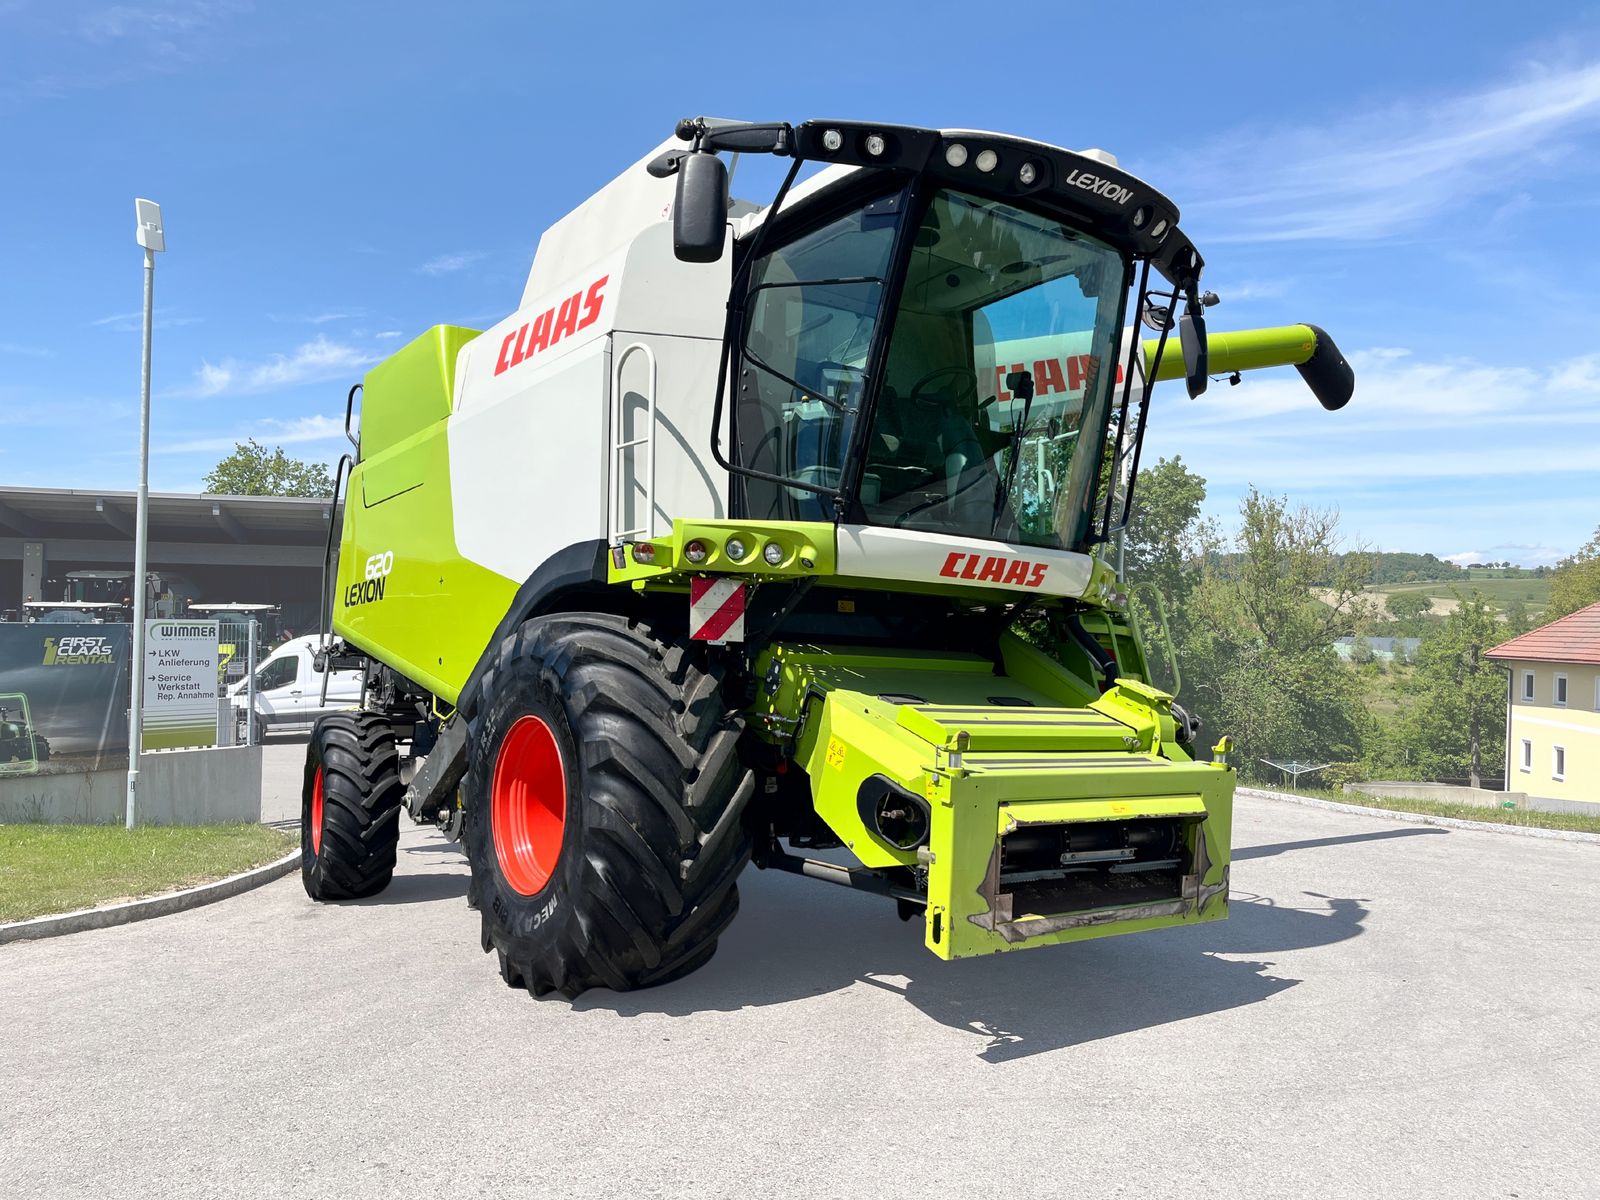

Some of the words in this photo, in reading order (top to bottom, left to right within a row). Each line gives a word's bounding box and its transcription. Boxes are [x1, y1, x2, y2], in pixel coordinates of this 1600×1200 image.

[1066, 169, 1134, 205] LEXION
[494, 274, 609, 377] CLAAS
[365, 550, 394, 580] 620
[939, 552, 1049, 587] CLAAS
[344, 576, 386, 608] LEXION
[161, 626, 216, 637] WIMMER
[59, 637, 107, 647] FIRST
[57, 645, 113, 656] CLAAS
[158, 649, 181, 657] LKW
[54, 655, 116, 665] RENTAL
[158, 659, 210, 667] Anlieferung
[157, 674, 192, 682] Service
[157, 683, 200, 691] Werkstatt
[157, 692, 176, 701] Rep.
[177, 691, 215, 699] Annahme
